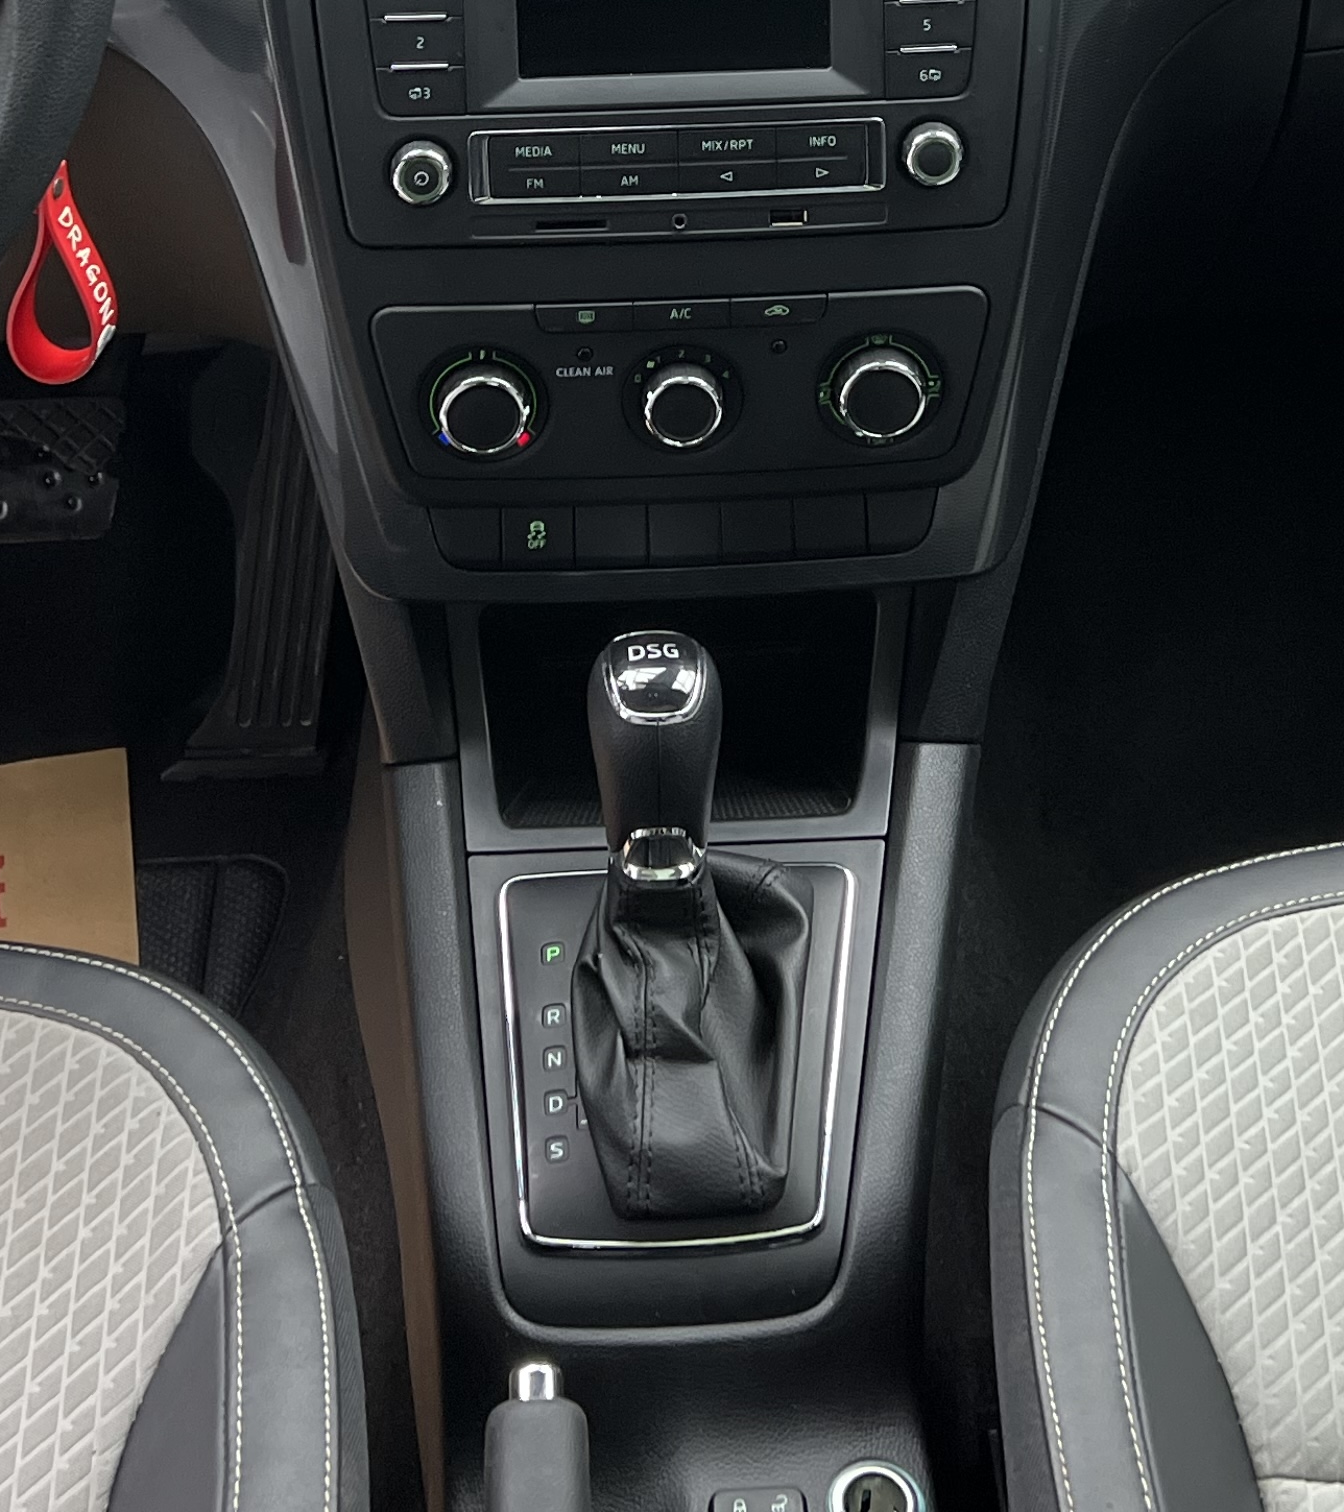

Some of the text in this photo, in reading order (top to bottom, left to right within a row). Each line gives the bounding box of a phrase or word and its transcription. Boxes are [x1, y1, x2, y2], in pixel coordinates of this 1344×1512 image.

[922, 18, 931, 31] 5
[416, 36, 425, 49] 2
[611, 143, 646, 154] MENU
[701, 139, 754, 152] MIX/RPT
[809, 136, 837, 148] INFO
[515, 146, 552, 158] MEDIA
[526, 178, 544, 189] FM
[620, 175, 639, 186] AM
[669, 307, 692, 319] A/C
[556, 366, 614, 377] CLEAN AIR
[527, 539, 547, 550] OFF
[627, 643, 680, 662] DSG
[547, 947, 560, 962] P
[547, 1010, 560, 1025] R
[548, 1052, 562, 1067] N
[549, 1097, 563, 1112] D
[550, 1142, 563, 1158] S
